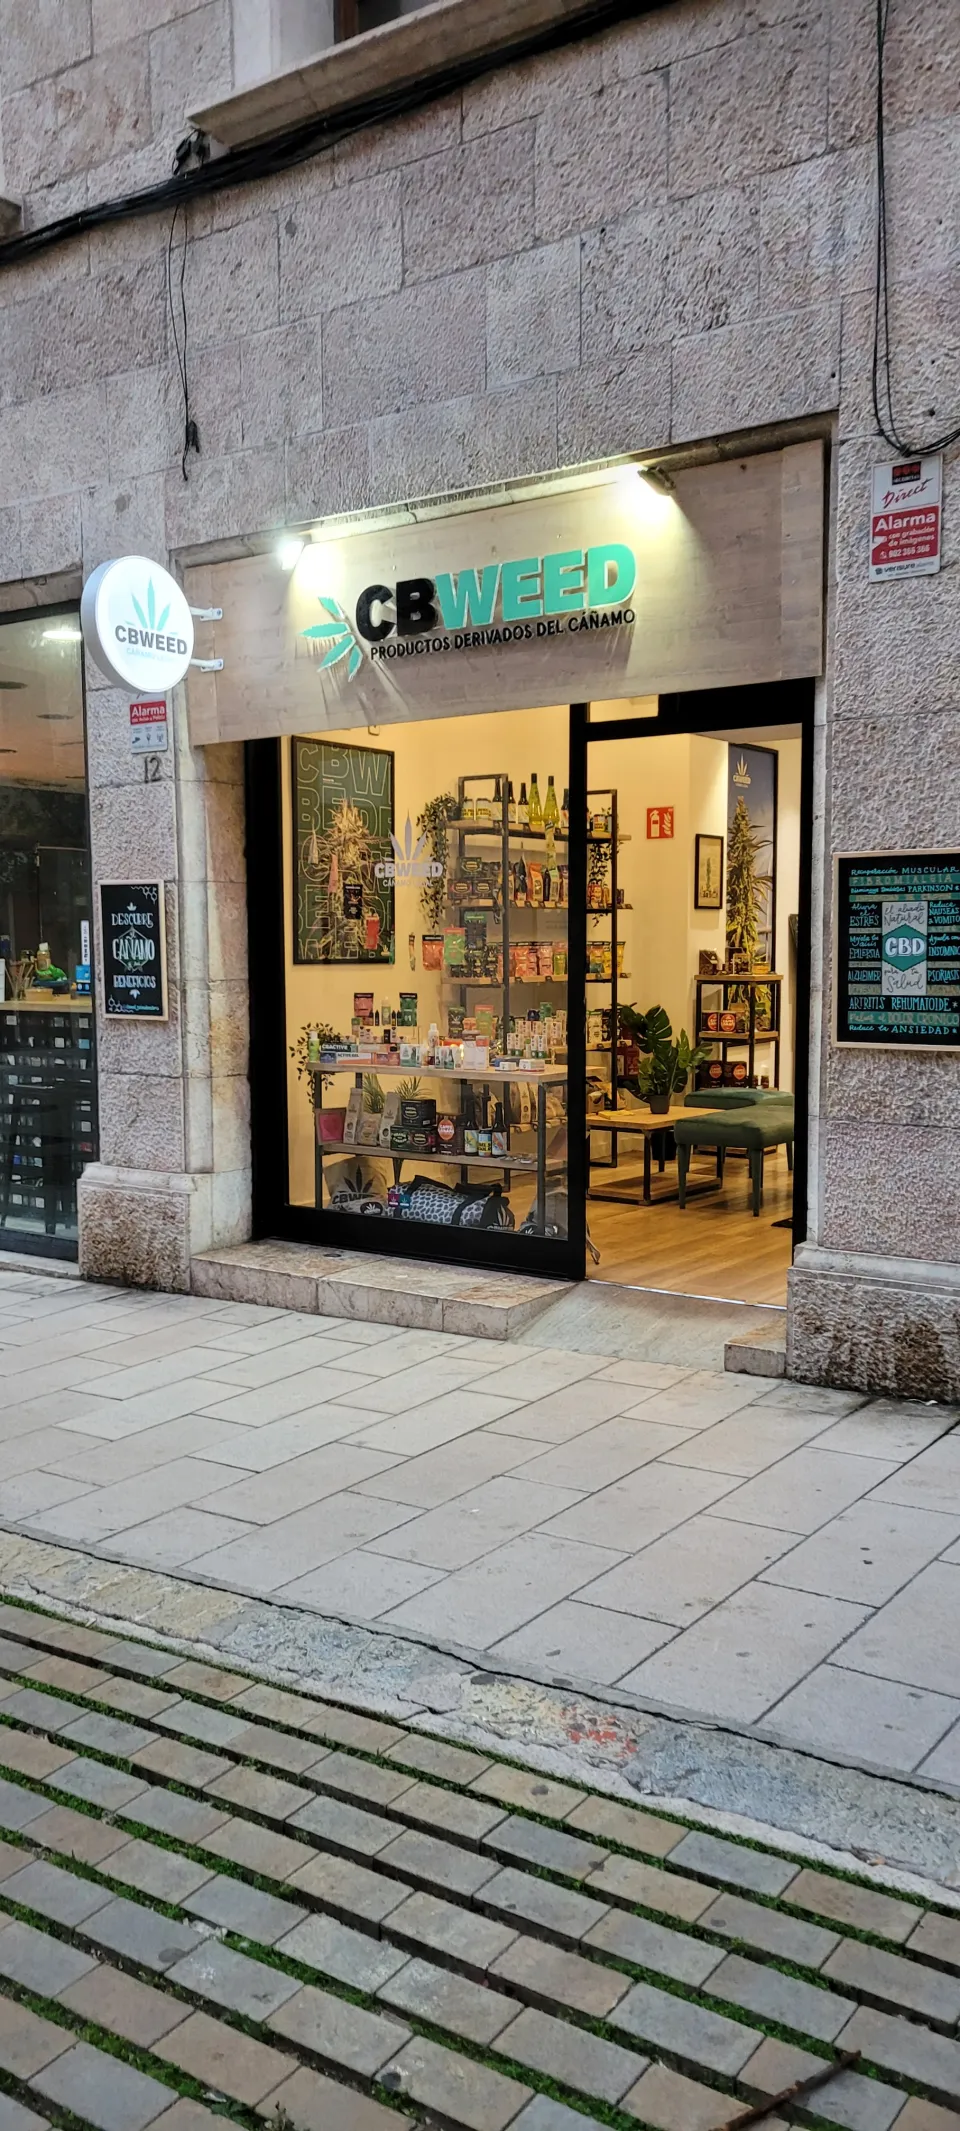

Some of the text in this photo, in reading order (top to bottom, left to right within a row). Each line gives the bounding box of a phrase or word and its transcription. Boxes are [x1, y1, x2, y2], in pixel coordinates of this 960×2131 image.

[882, 478, 934, 509] Direct
[875, 512, 936, 532] Alarma
[355, 543, 638, 642] CBWEED
[114, 624, 188, 655] CBWEED
[370, 609, 636, 661] PRODUCTOS DERIVADOS DEL CÁÑAMO
[131, 705, 166, 718] Alarma
[143, 756, 162, 784] 12
[374, 861, 444, 878] CBWEED
[902, 866, 960, 874] MUSCULAR
[851, 874, 953, 886] FIBROMIALGIA
[907, 884, 954, 893] PARKINSON
[884, 912, 925, 926] Natural
[884, 937, 926, 957] CBD
[113, 975, 157, 988] BENEFICIOS
[848, 970, 881, 981] ALZHEIMER
[886, 974, 924, 993] Salud
[849, 996, 952, 1012] ARTRITIS REHUMATOIDE
[891, 1025, 950, 1035] ANSIEDAD
